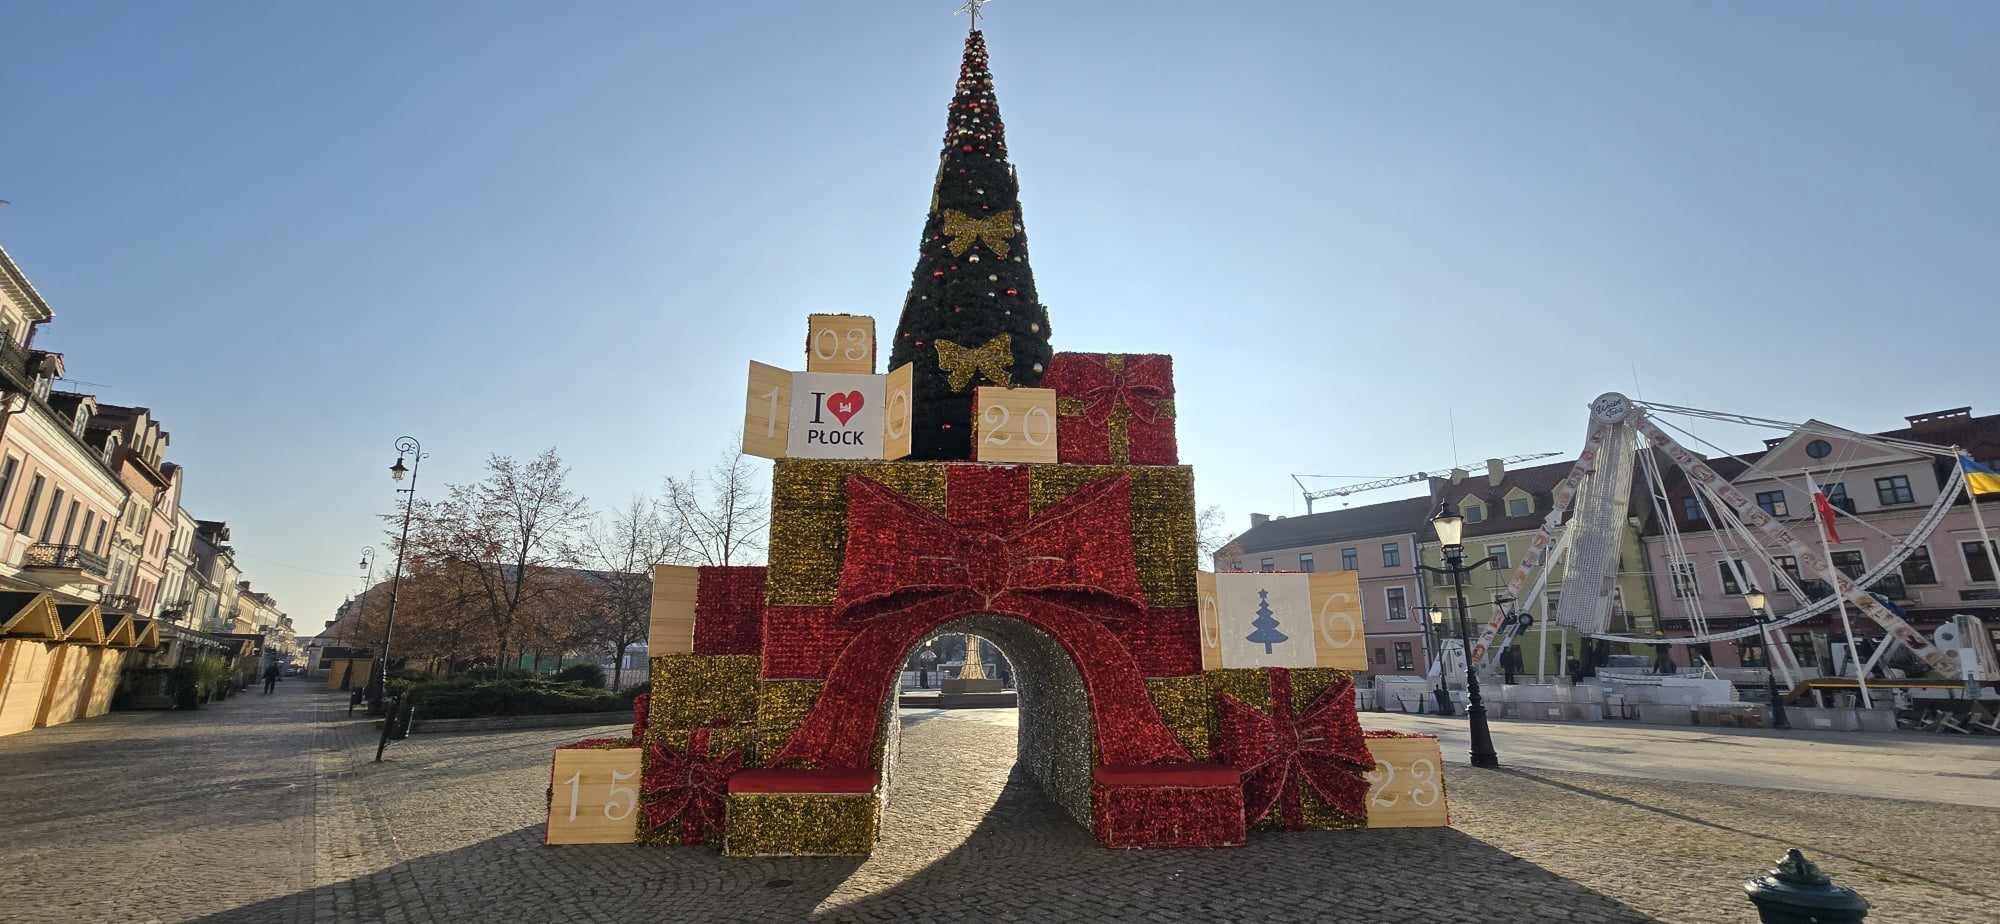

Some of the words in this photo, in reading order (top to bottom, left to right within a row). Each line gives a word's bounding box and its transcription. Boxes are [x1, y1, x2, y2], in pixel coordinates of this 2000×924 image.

[760, 386, 780, 439] 1
[809, 391, 826, 424] I
[984, 404, 1052, 445] 20
[807, 429, 864, 445] PŁOCK
[1320, 592, 1355, 648] 6
[563, 768, 639, 822] 15
[1365, 759, 1439, 808] 23
